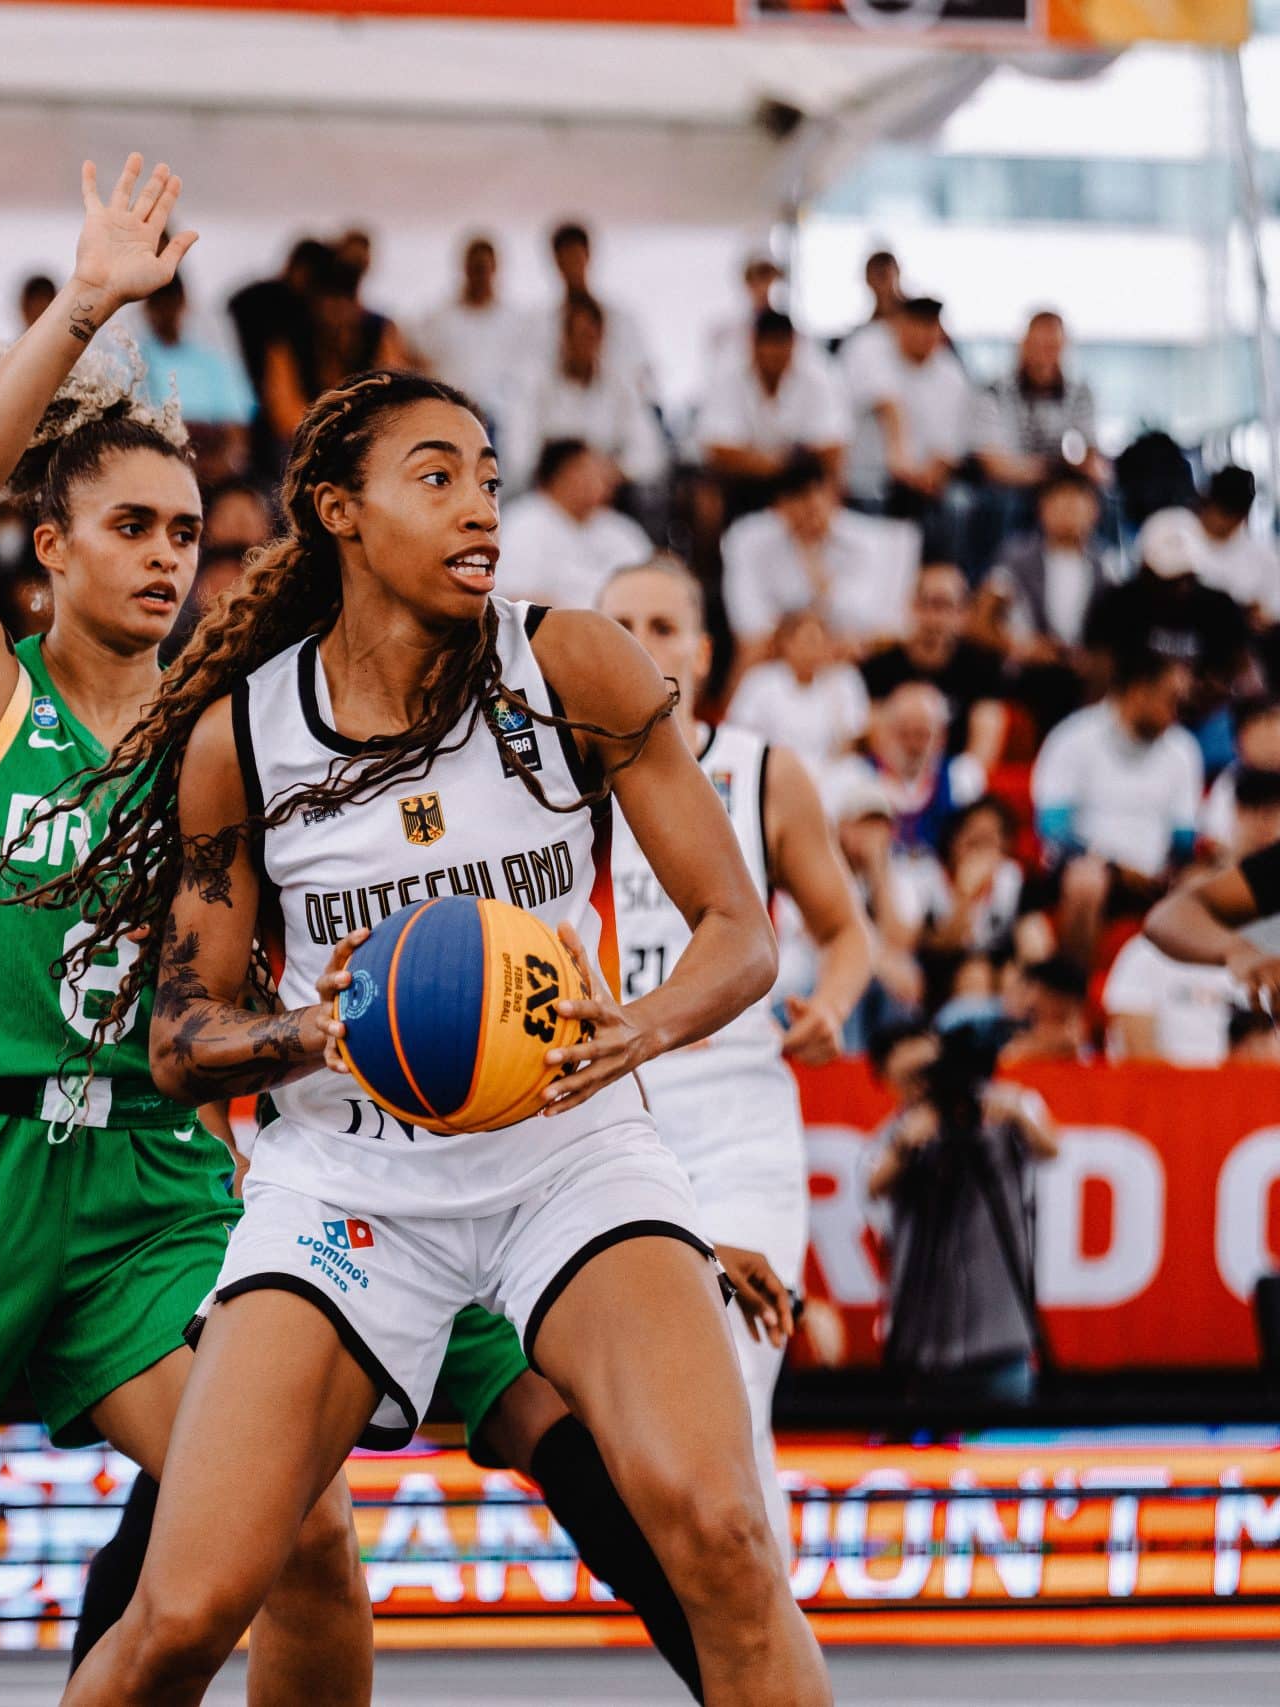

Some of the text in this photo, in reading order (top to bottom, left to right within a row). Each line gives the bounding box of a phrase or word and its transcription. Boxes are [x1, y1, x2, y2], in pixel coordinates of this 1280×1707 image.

[59, 919, 141, 1044] 8
[500, 952, 513, 1024] OFFICIAL BALL
[513, 966, 523, 990] FIBA
[338, 1098, 458, 1142] IN
[310, 1254, 349, 1294] Pizza
